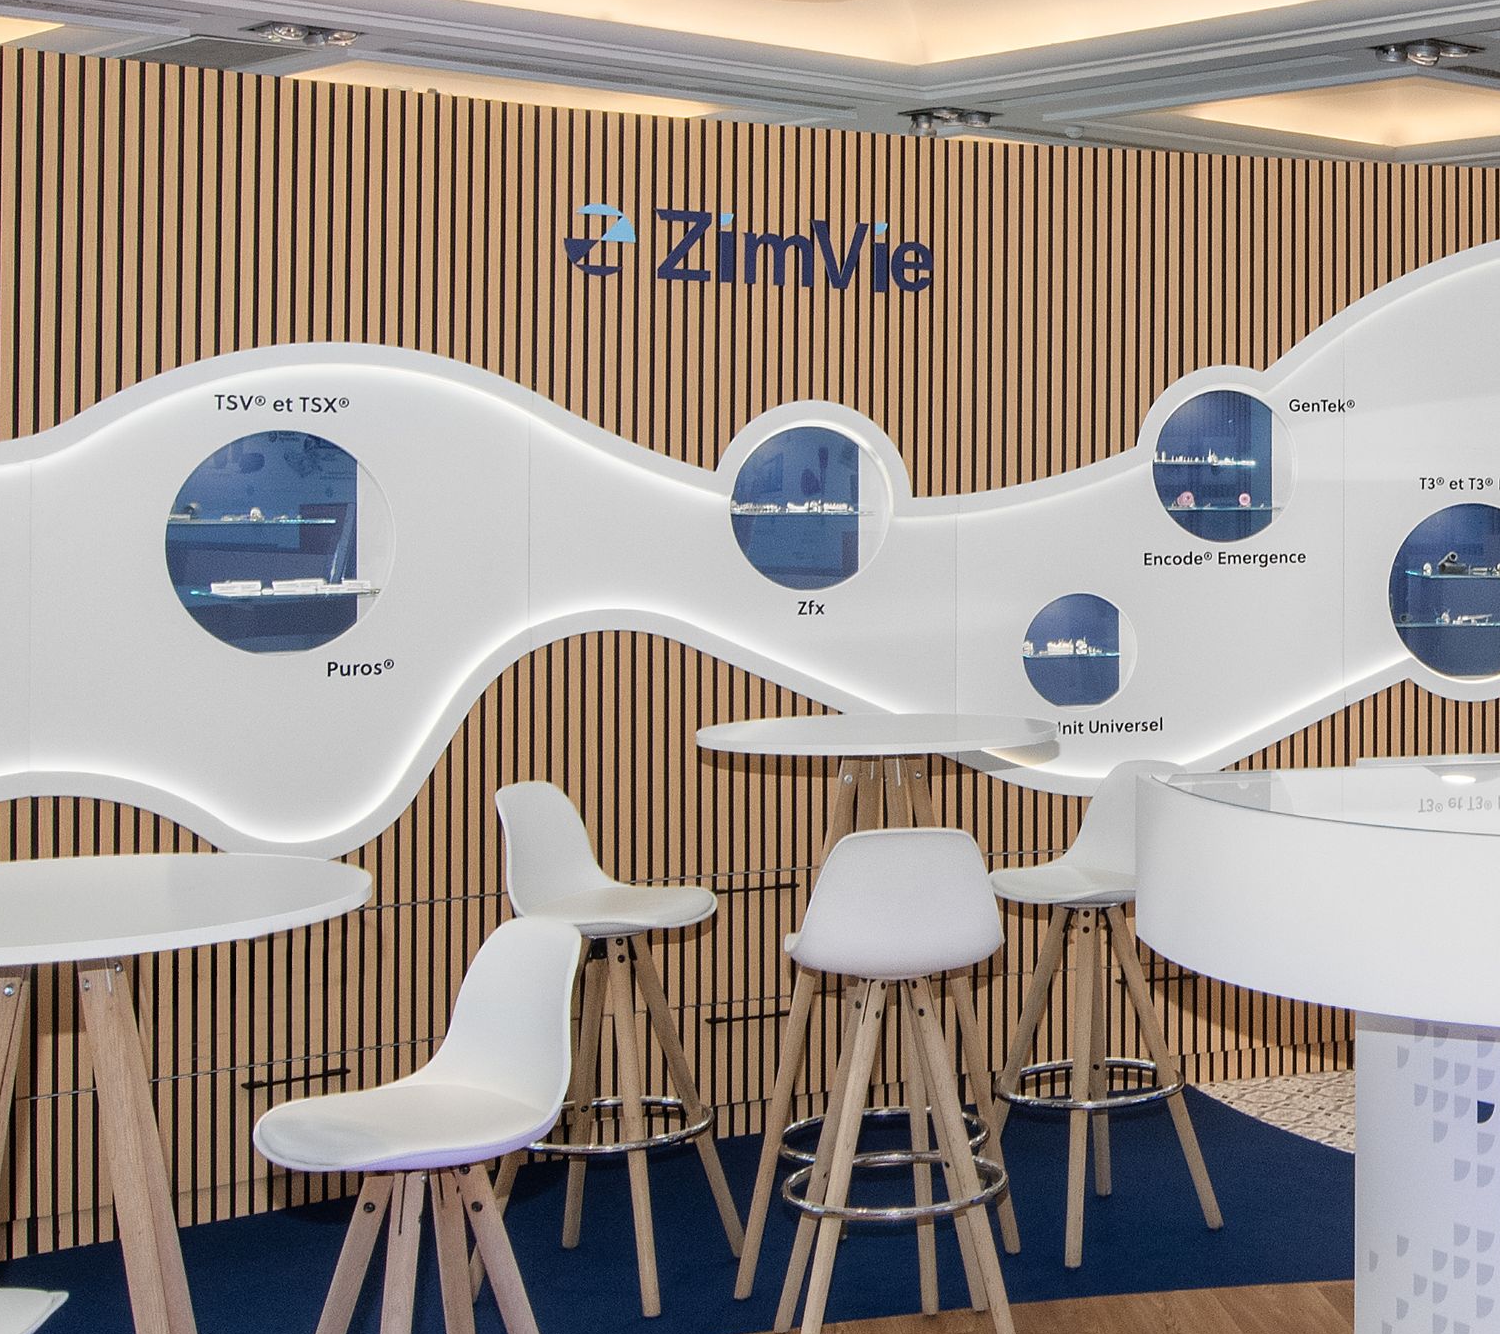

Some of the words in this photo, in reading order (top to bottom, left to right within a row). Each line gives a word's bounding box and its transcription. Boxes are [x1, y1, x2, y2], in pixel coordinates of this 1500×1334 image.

[655, 207, 935, 293] ZimVie
[215, 394, 266, 411] TSV®
[273, 397, 293, 413] et
[300, 397, 350, 414] TSX®
[1289, 398, 1355, 413] GenTek®
[1419, 477, 1445, 491] T3®
[1449, 478, 1463, 491] et
[1468, 477, 1493, 491] T3®
[1143, 551, 1213, 566] Encode®
[1217, 551, 1307, 568] Emergence
[797, 601, 825, 616] Zfx
[327, 658, 395, 678] Puros®
[1058, 721, 1084, 735] nit
[1089, 717, 1163, 734] Universel
